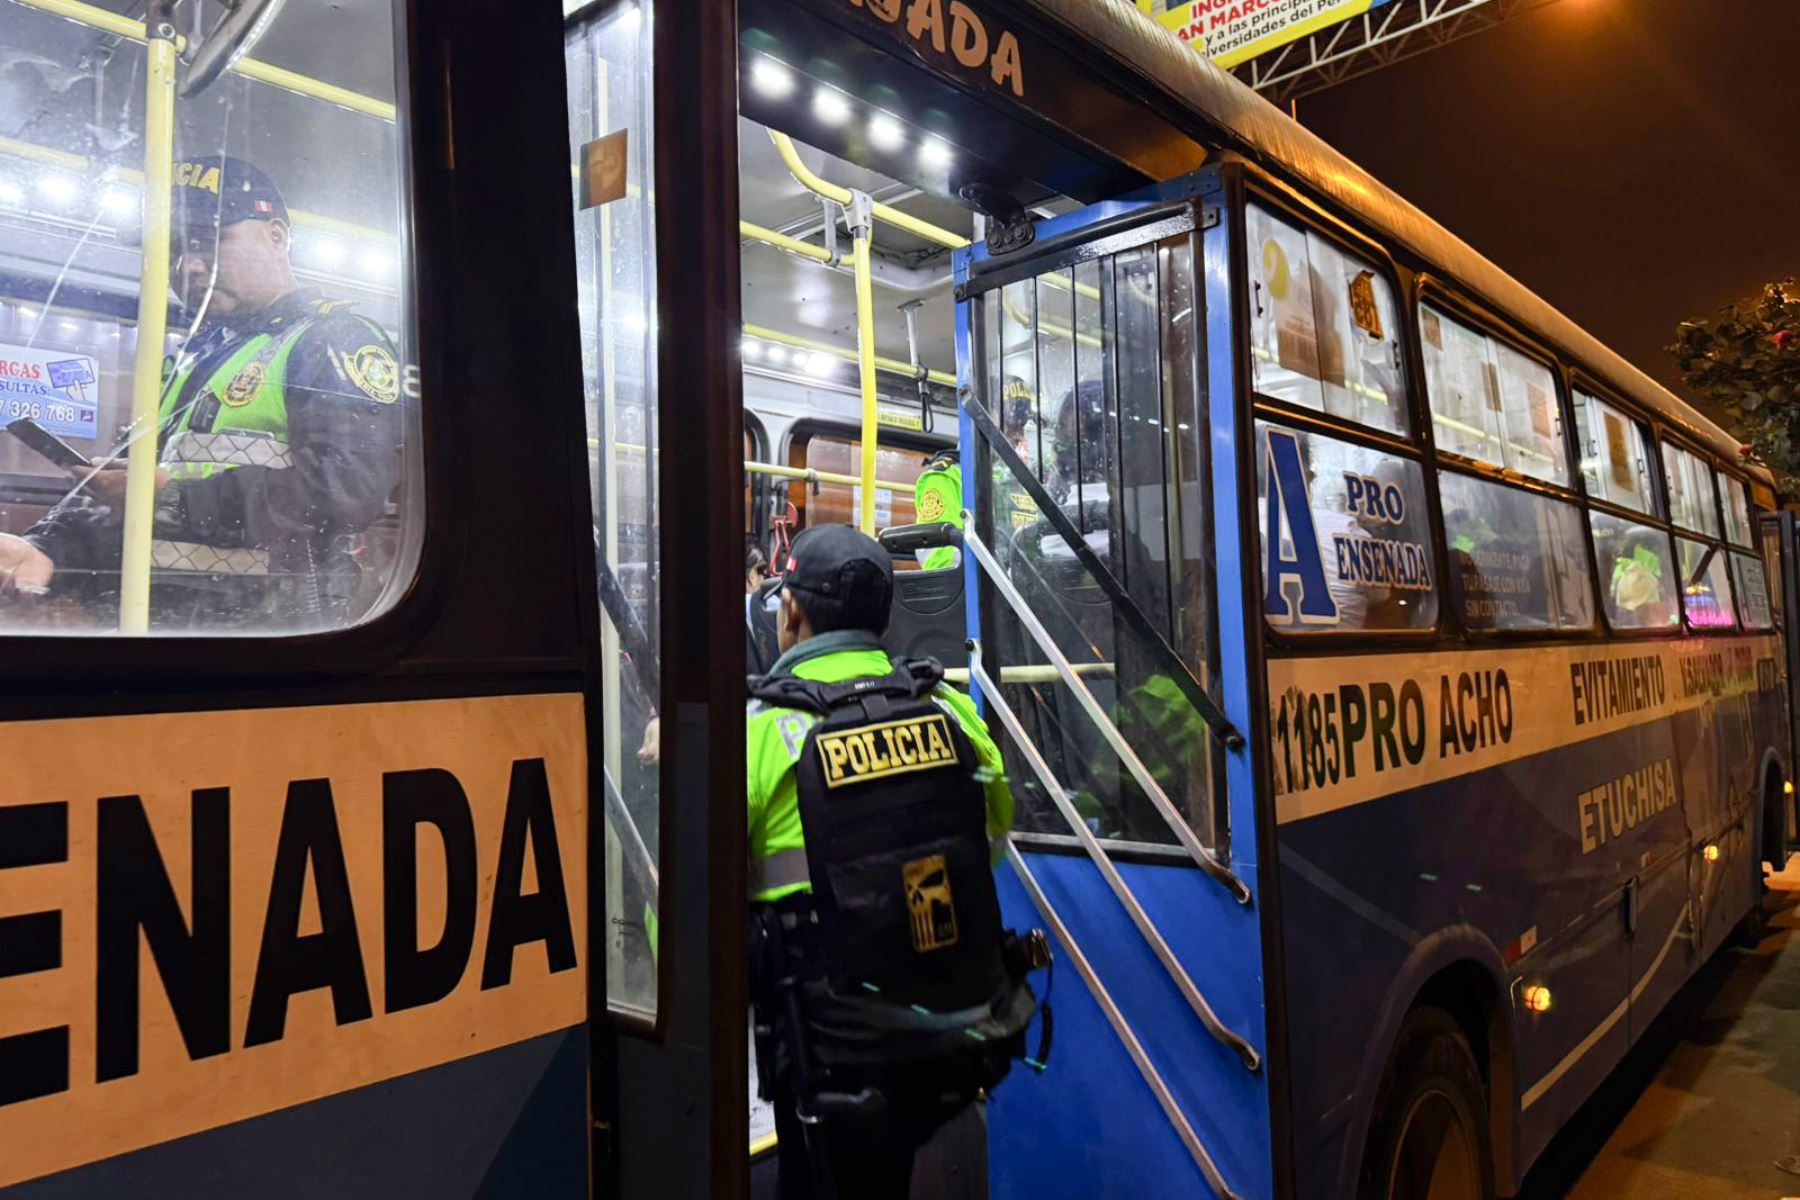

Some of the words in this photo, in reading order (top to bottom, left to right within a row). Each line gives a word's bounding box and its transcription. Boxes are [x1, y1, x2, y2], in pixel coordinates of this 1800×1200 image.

[1205, 34, 1213, 47] y
[1217, 30, 1225, 40] a
[1228, 20, 1248, 34] las
[1290, 4, 1313, 21] del
[10, 400, 41, 419] 326
[46, 404, 76, 422] 768
[1343, 471, 1405, 525] PRO
[1333, 533, 1432, 590] ENSENADA
[1440, 668, 1512, 758] ACHO
[1570, 655, 1665, 725] EVITAMIENTO
[823, 722, 950, 779] POLICIA
[1577, 757, 1677, 855] ETUCHISA
